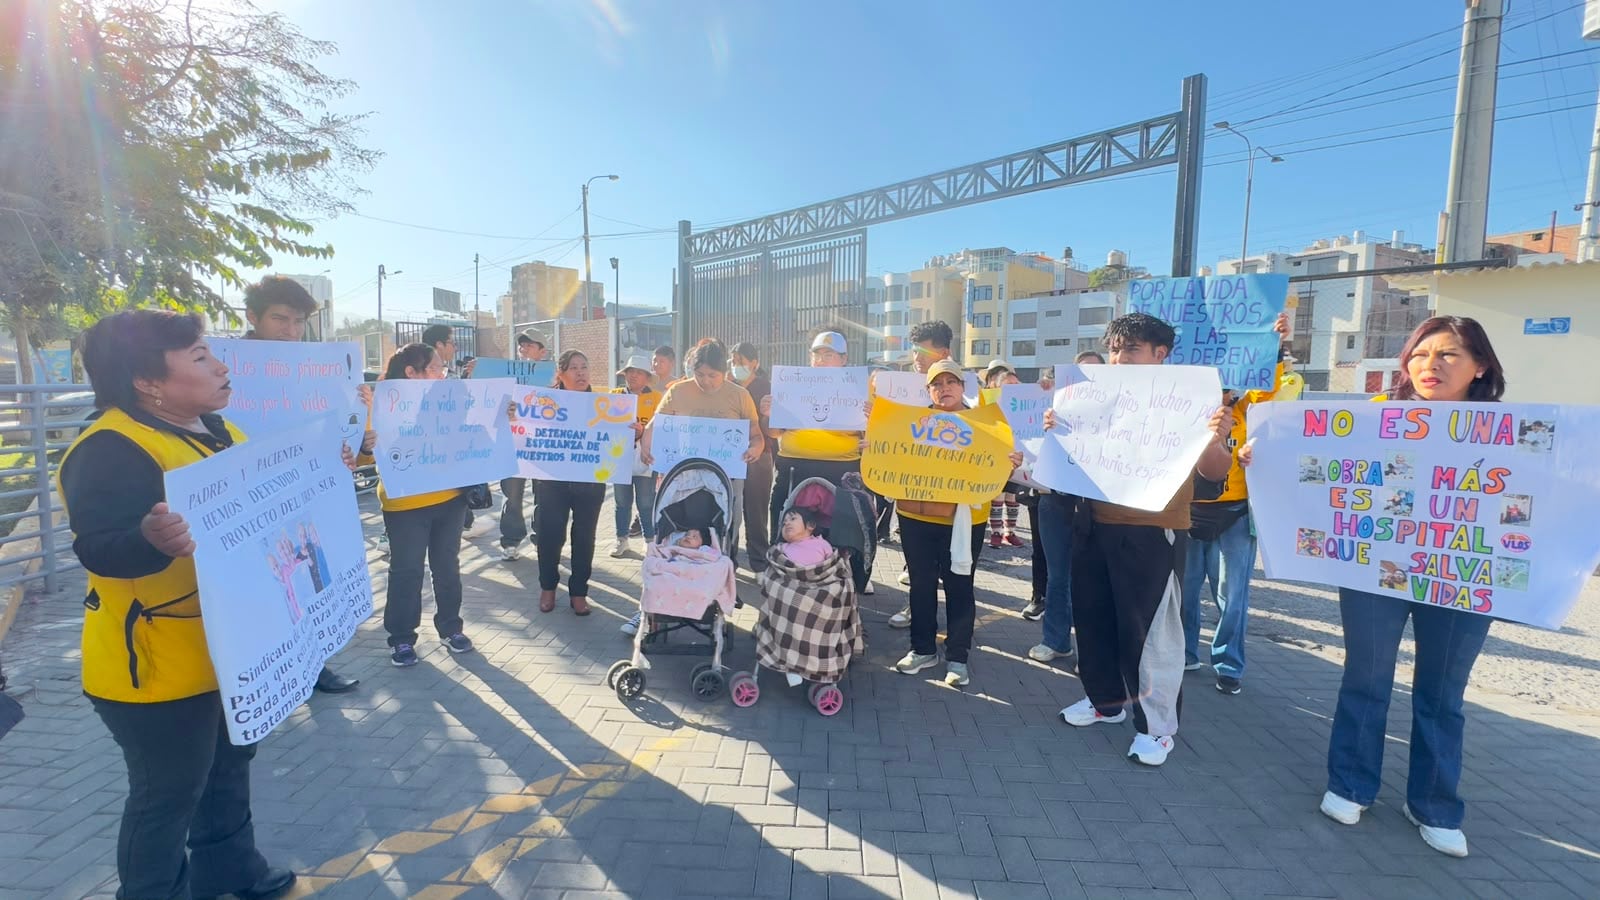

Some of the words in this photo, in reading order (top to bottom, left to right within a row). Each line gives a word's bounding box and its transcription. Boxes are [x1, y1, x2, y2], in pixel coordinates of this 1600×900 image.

[1130, 280, 1165, 300] POR
[1171, 280, 1194, 300] LA
[1200, 277, 1248, 300] VIDA
[1159, 302, 1262, 325] NUESTROS
[1194, 327, 1228, 345] LAS
[1191, 346, 1257, 365] DEBEN
[301, 390, 328, 411] vida
[388, 388, 413, 412] Por
[438, 388, 456, 412] vida
[1150, 376, 1192, 414] luchan
[516, 402, 568, 421] VLOS
[1303, 408, 1354, 438] NO
[1379, 407, 1432, 440] ES
[1448, 409, 1514, 445] UNA
[526, 438, 584, 450] ESPERANZA
[587, 441, 600, 451] DE
[535, 428, 587, 441] DETENGAN
[597, 431, 610, 442] LA
[911, 422, 973, 446] VLOS
[1157, 417, 1182, 462] hijo
[418, 442, 447, 464] deben
[516, 450, 565, 461] NUESTROS
[893, 441, 907, 455] ES
[910, 443, 932, 458] UNA
[936, 447, 967, 462] OBRA
[188, 477, 229, 510] PADRES
[240, 464, 247, 481] Y
[257, 444, 304, 472] PACIENTES
[867, 467, 880, 481] ES
[883, 470, 897, 484] UN
[899, 471, 943, 489] HOSPITAL
[947, 477, 965, 491] QUE
[1328, 458, 1384, 487] OBRA
[1431, 457, 1512, 495] MÁS
[202, 498, 243, 531] HEMOS
[248, 468, 300, 503] DEFENDIDO
[309, 458, 321, 472] EL
[1329, 487, 1372, 511] ES
[1429, 495, 1479, 522] UN
[220, 508, 277, 551] PROYECTO
[280, 497, 300, 516] DEL
[319, 476, 337, 492] SUR
[1333, 511, 1493, 554] HOSPITAL
[1502, 538, 1531, 551] VLOS
[1324, 537, 1371, 565] QUE
[1409, 551, 1493, 586] SALVA
[1411, 576, 1493, 613] VIDAS
[234, 694, 279, 724] Cada
[281, 678, 298, 698] día
[327, 624, 338, 636] la
[238, 639, 294, 688] Sindicato
[230, 682, 269, 710] Para
[274, 658, 294, 681] que
[242, 680, 313, 741] tratamient
